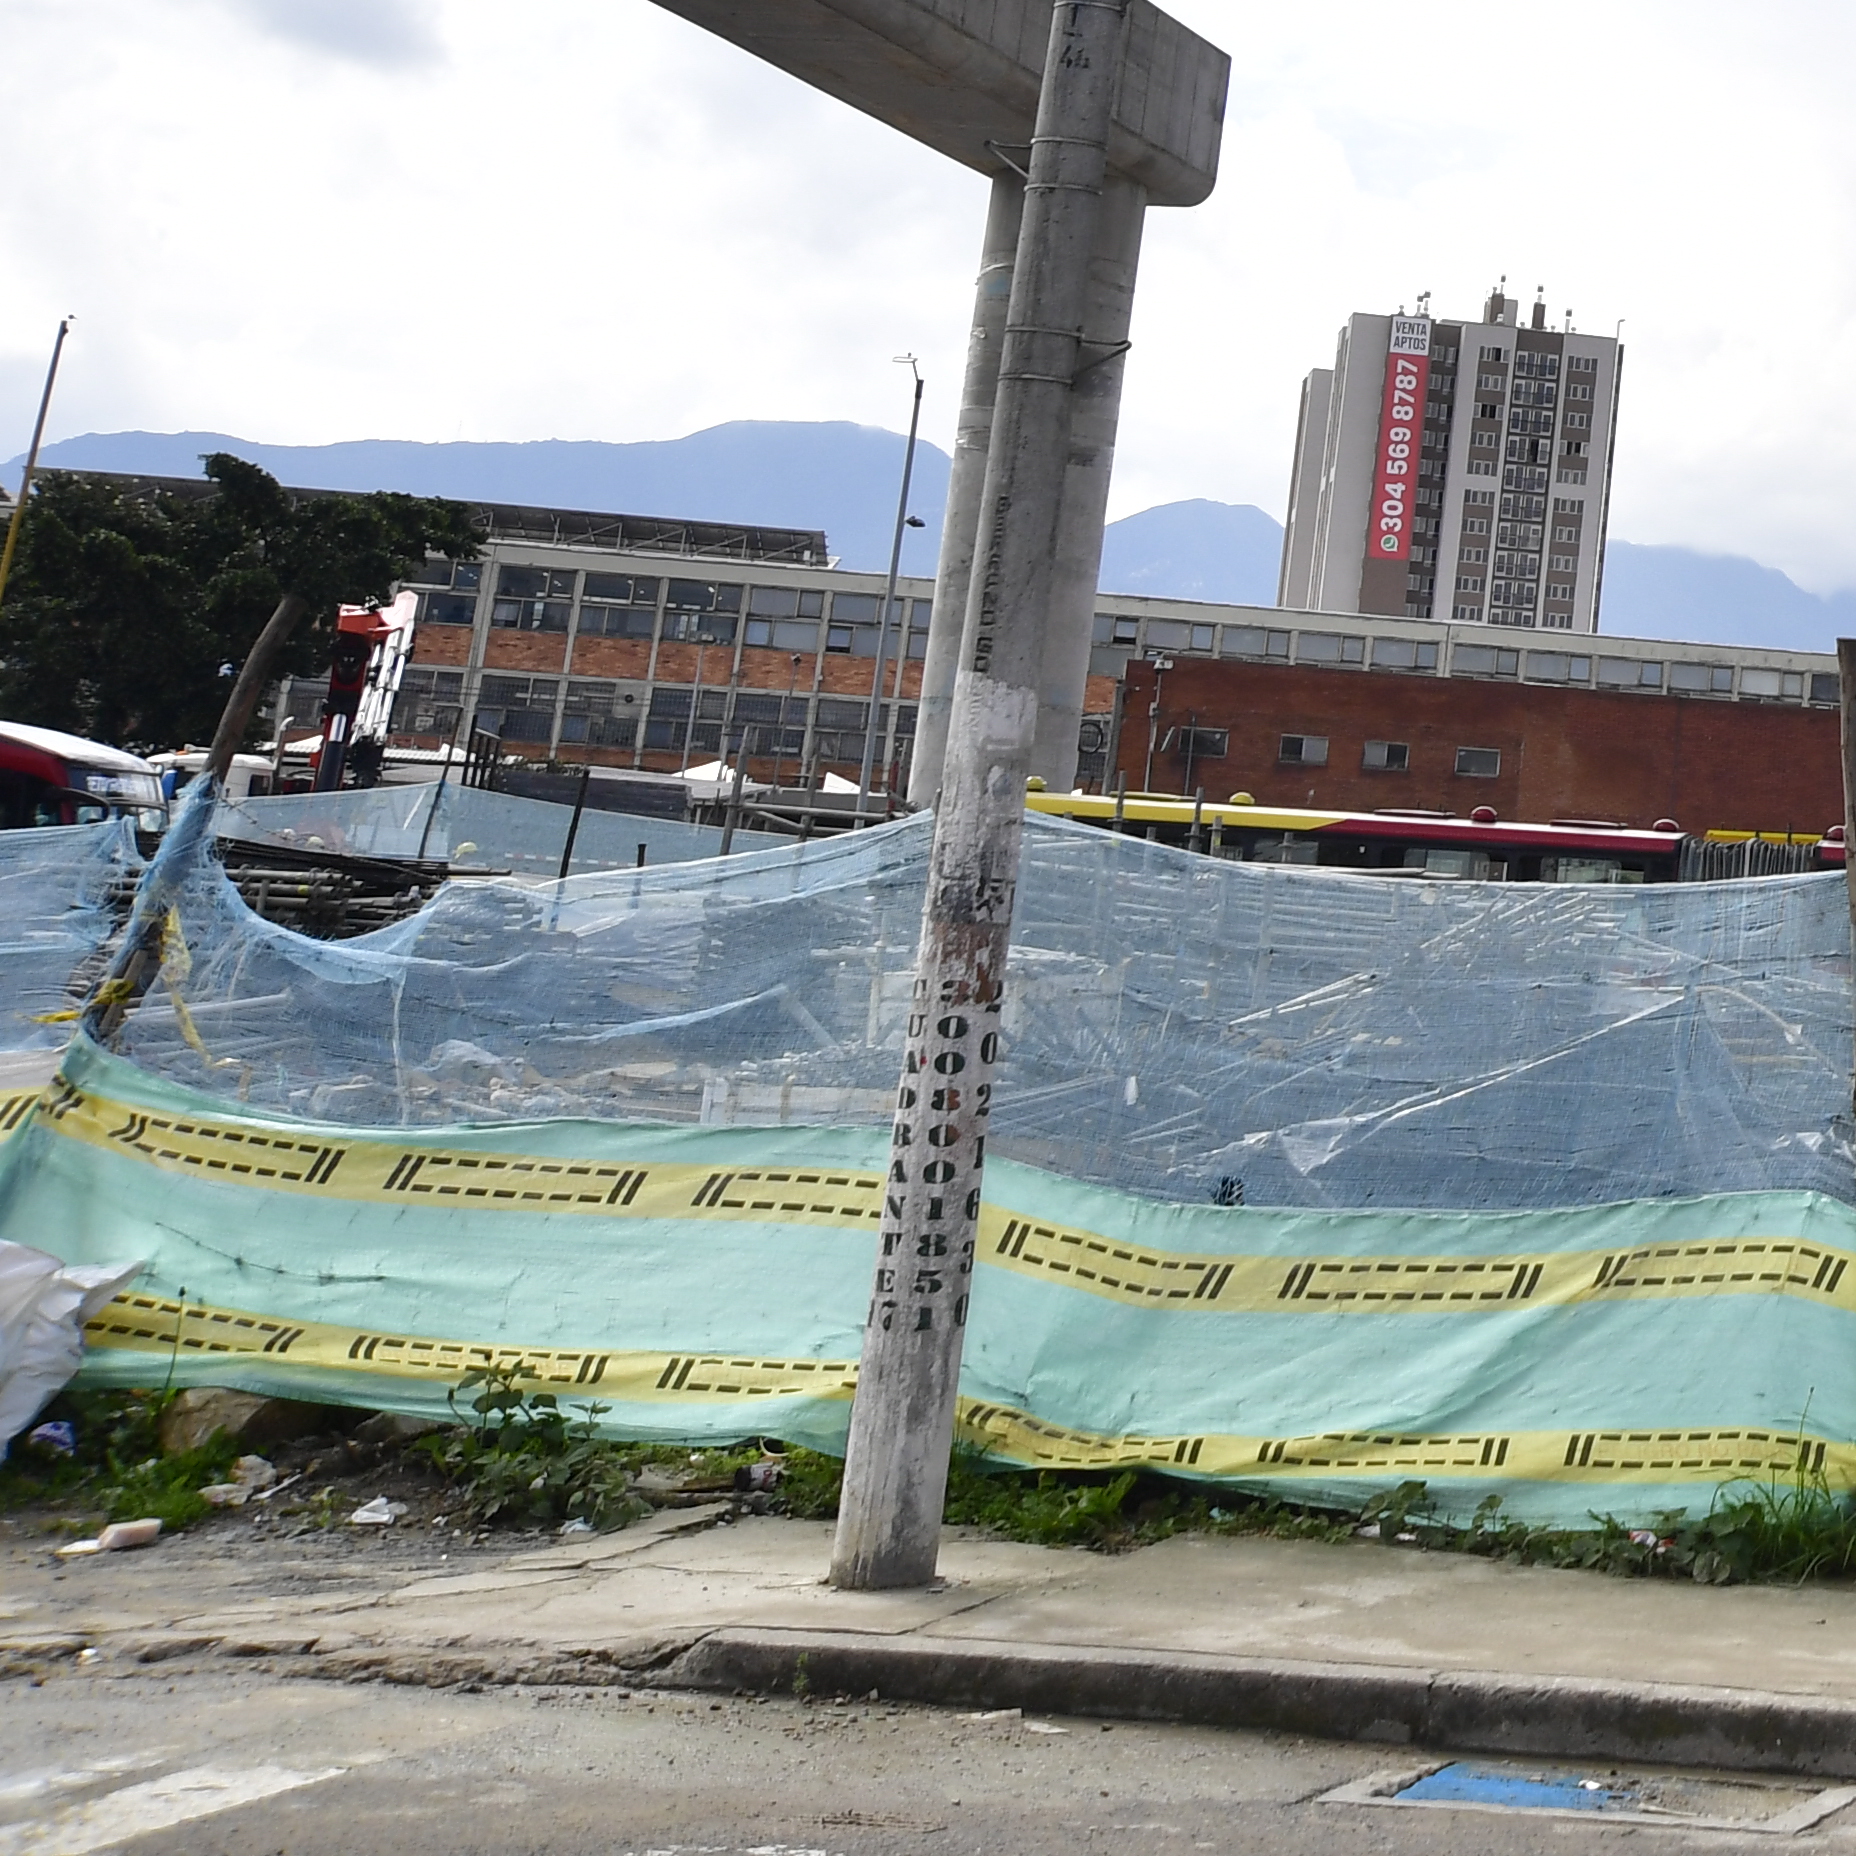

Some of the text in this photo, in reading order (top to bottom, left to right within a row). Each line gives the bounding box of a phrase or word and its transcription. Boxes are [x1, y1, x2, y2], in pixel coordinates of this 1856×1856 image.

[1395, 320, 1428, 336] VENTA
[1392, 335, 1427, 351] APTOS
[1380, 358, 1419, 532] 304 569 8787
